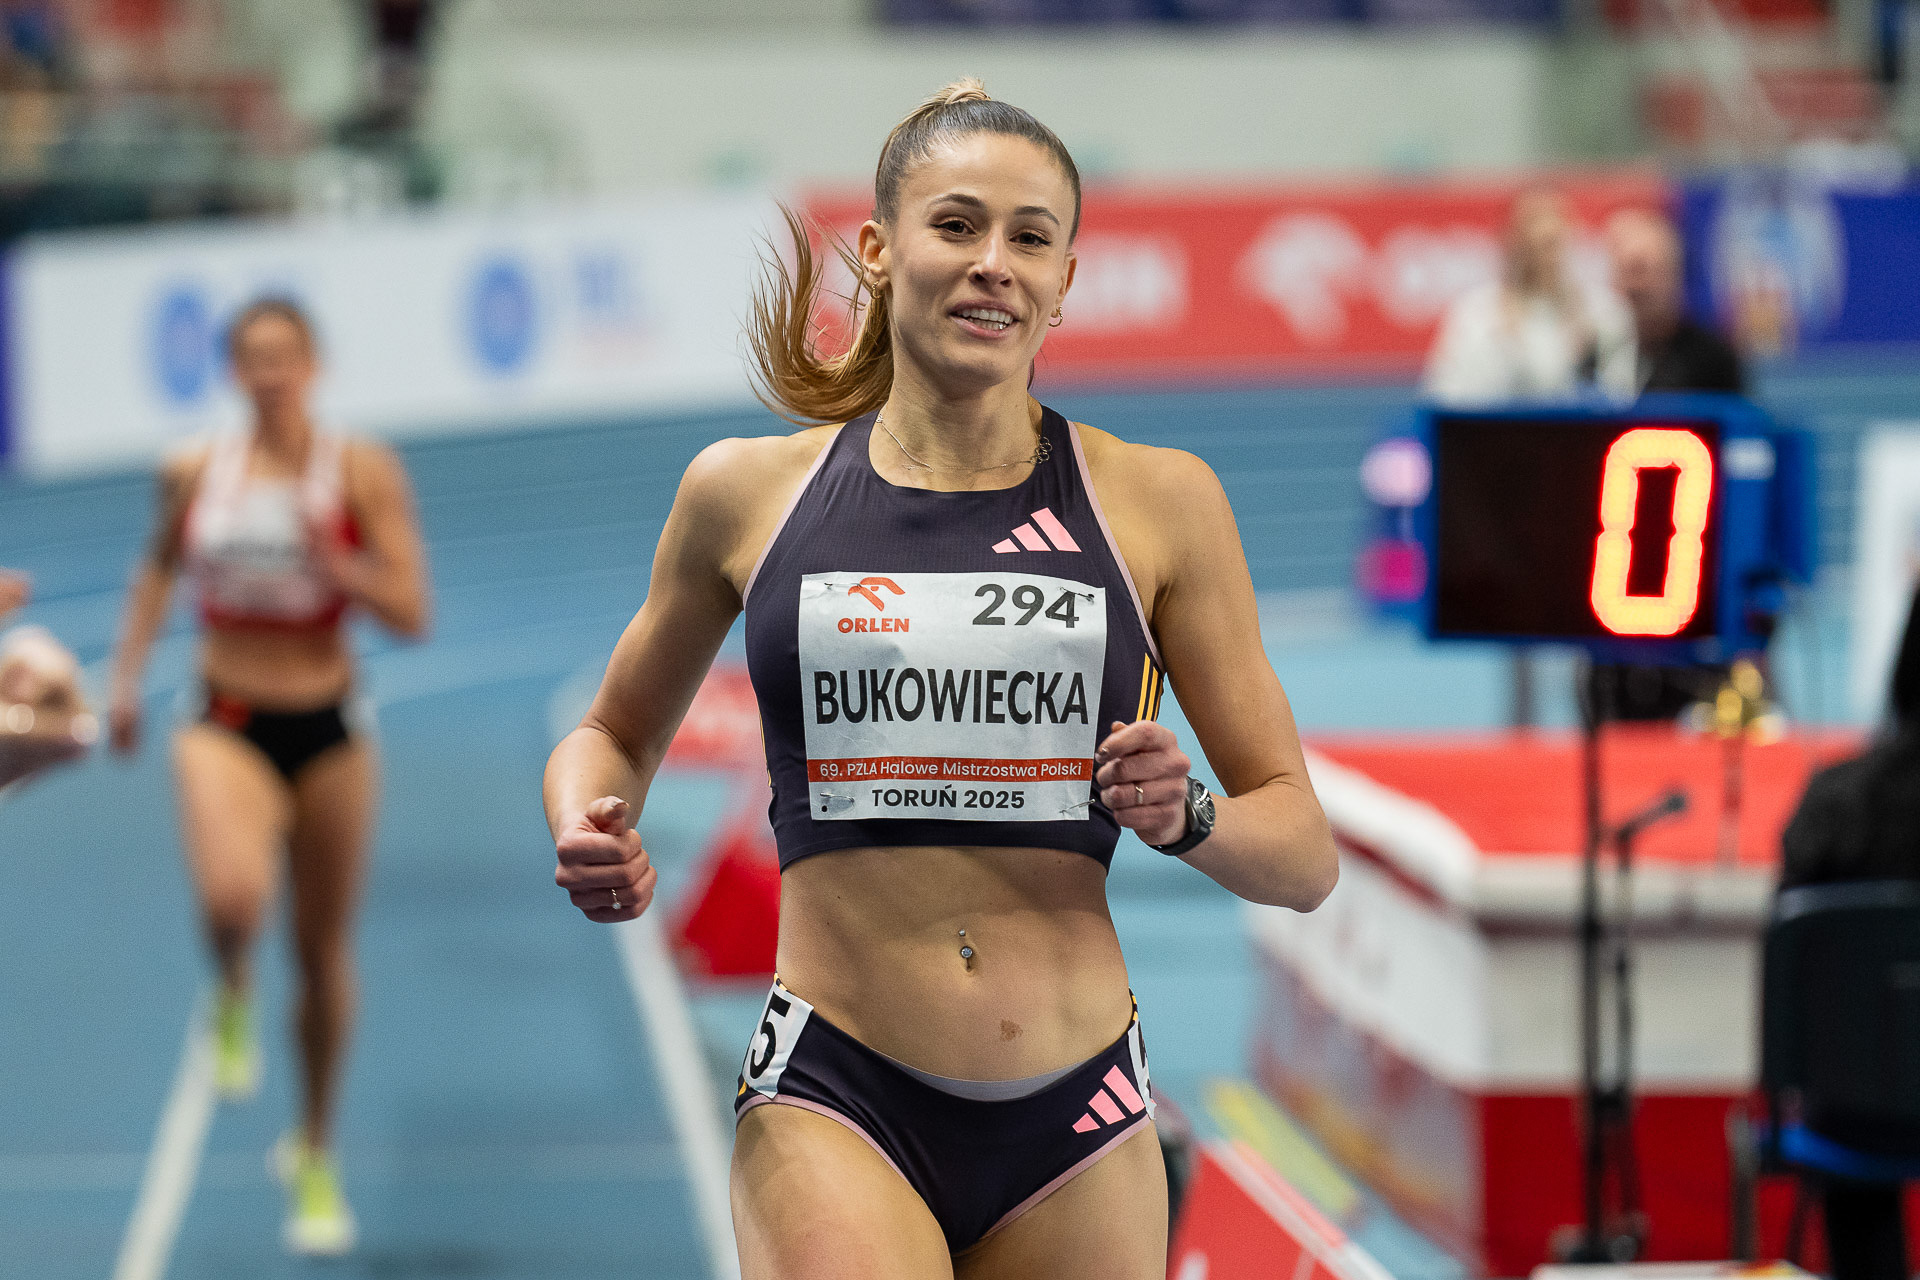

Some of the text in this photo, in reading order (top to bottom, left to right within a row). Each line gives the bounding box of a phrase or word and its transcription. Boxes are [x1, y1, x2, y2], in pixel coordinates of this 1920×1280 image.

[1591, 428, 1712, 636] 0
[837, 617, 910, 634] ORLEN
[972, 583, 1080, 628] 294
[813, 668, 1089, 725] BUKOWIECKA
[820, 761, 1082, 777] 69. PZLA Halowe Mistrzostwa Polski
[872, 784, 1025, 809] TORUŃ 2025
[750, 991, 791, 1079] 5
